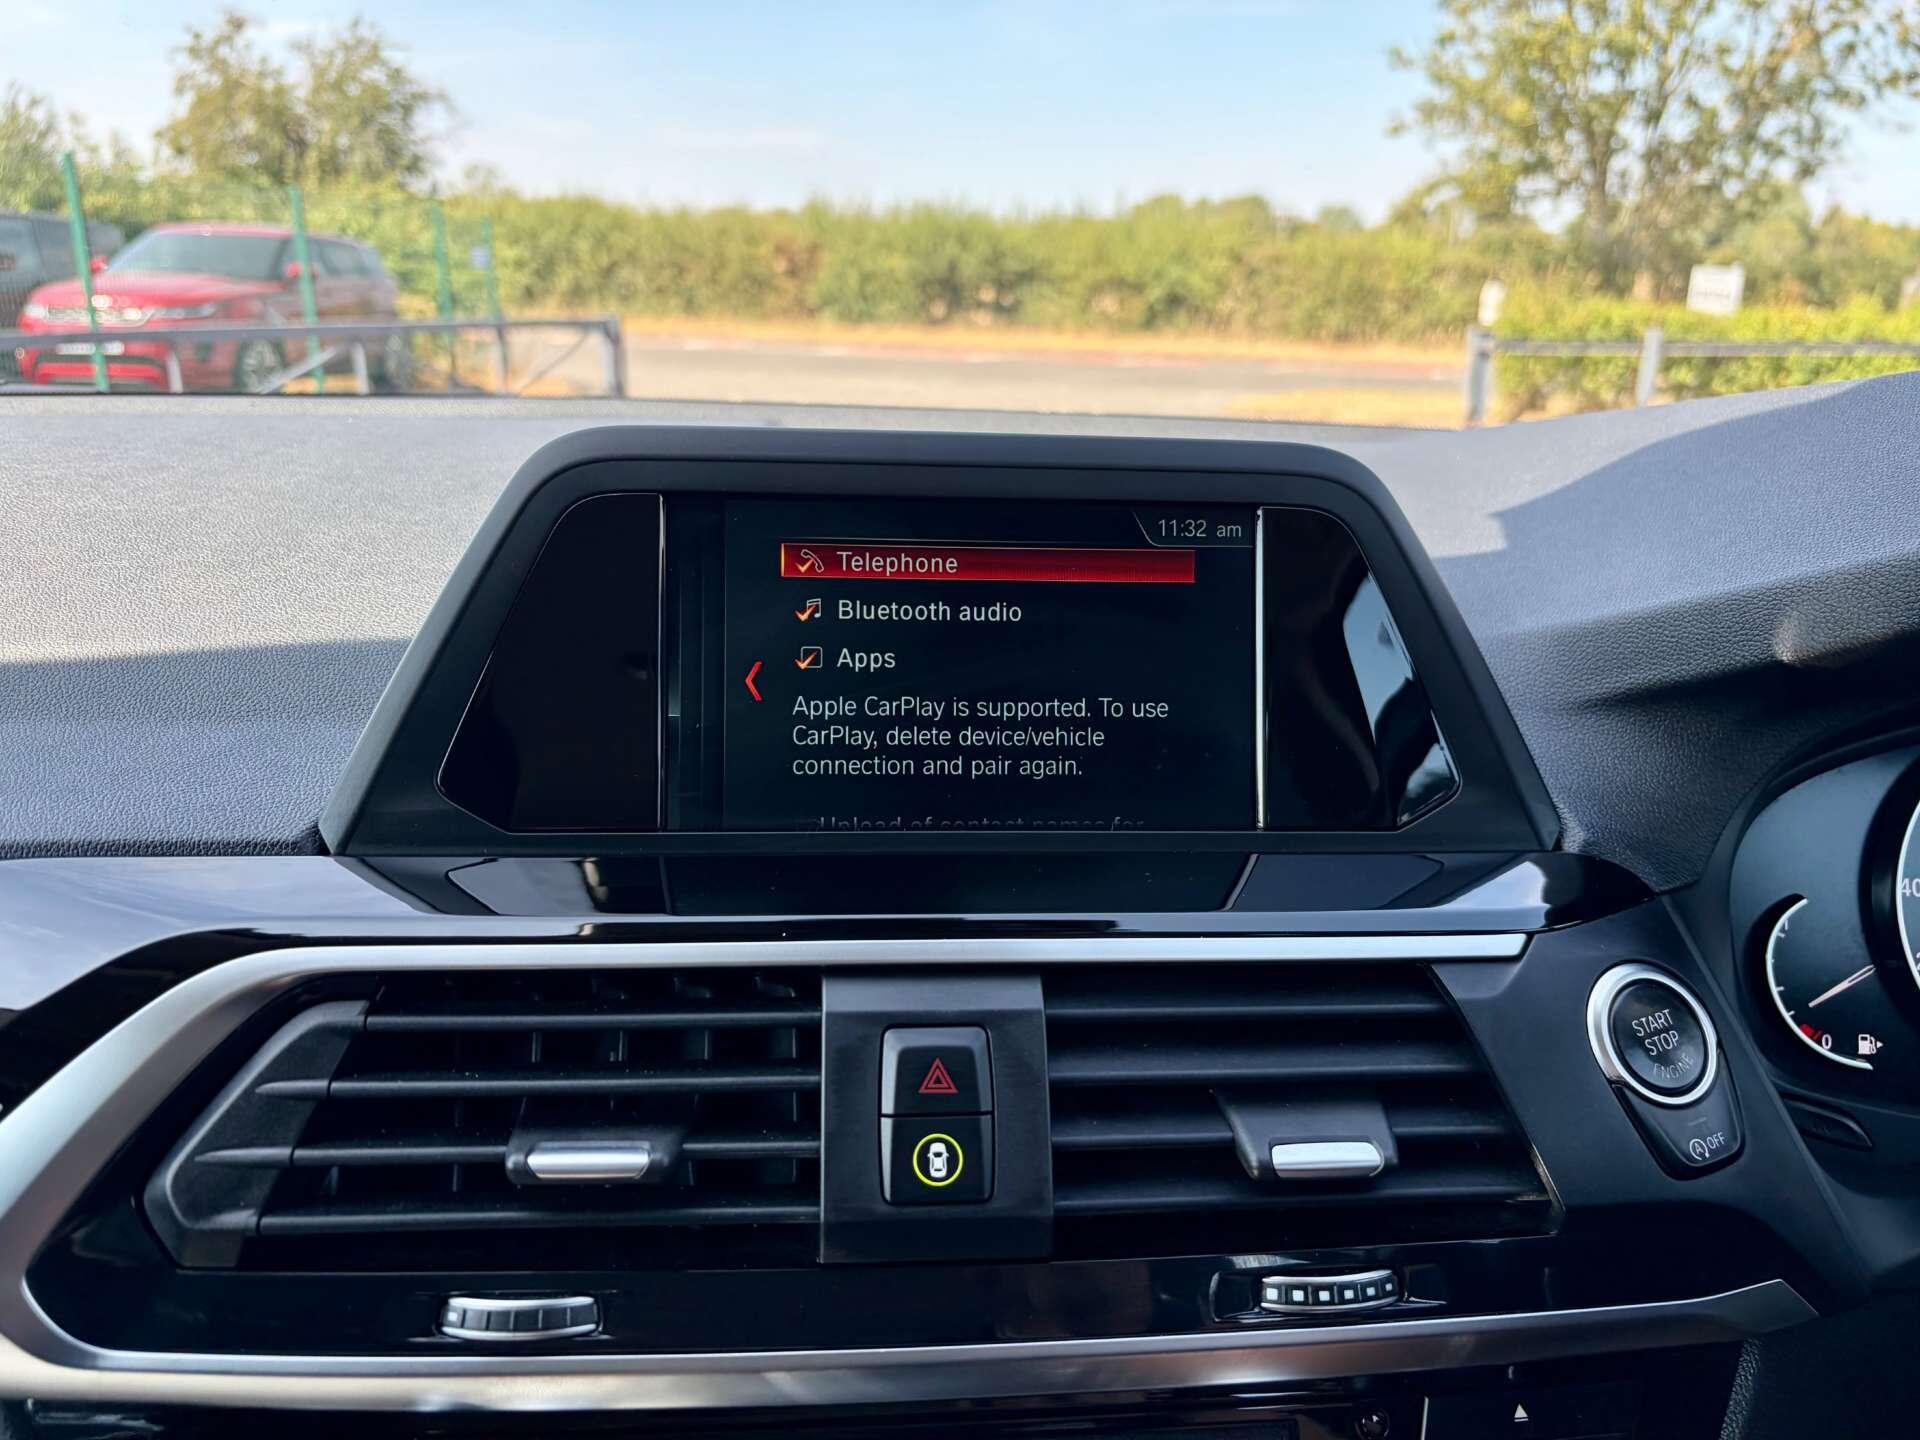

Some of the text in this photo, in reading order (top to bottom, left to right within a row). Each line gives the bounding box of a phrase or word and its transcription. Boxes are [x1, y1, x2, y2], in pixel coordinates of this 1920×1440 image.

[1158, 519, 1242, 538] 11:32 am
[837, 551, 959, 576] Telephone
[838, 599, 1022, 622] Bluetooth audio
[836, 647, 896, 673] Apps
[792, 695, 1169, 721] Apple CarPlay is supported. To use
[792, 724, 1105, 750] CarPlay, delete device/vehicle
[792, 755, 1083, 780] connection and pair again.
[1631, 1009, 1673, 1037] START
[1644, 1030, 1679, 1056] STOP
[1652, 1052, 1694, 1079] ENGINE
[1706, 1131, 1725, 1149] OFF
